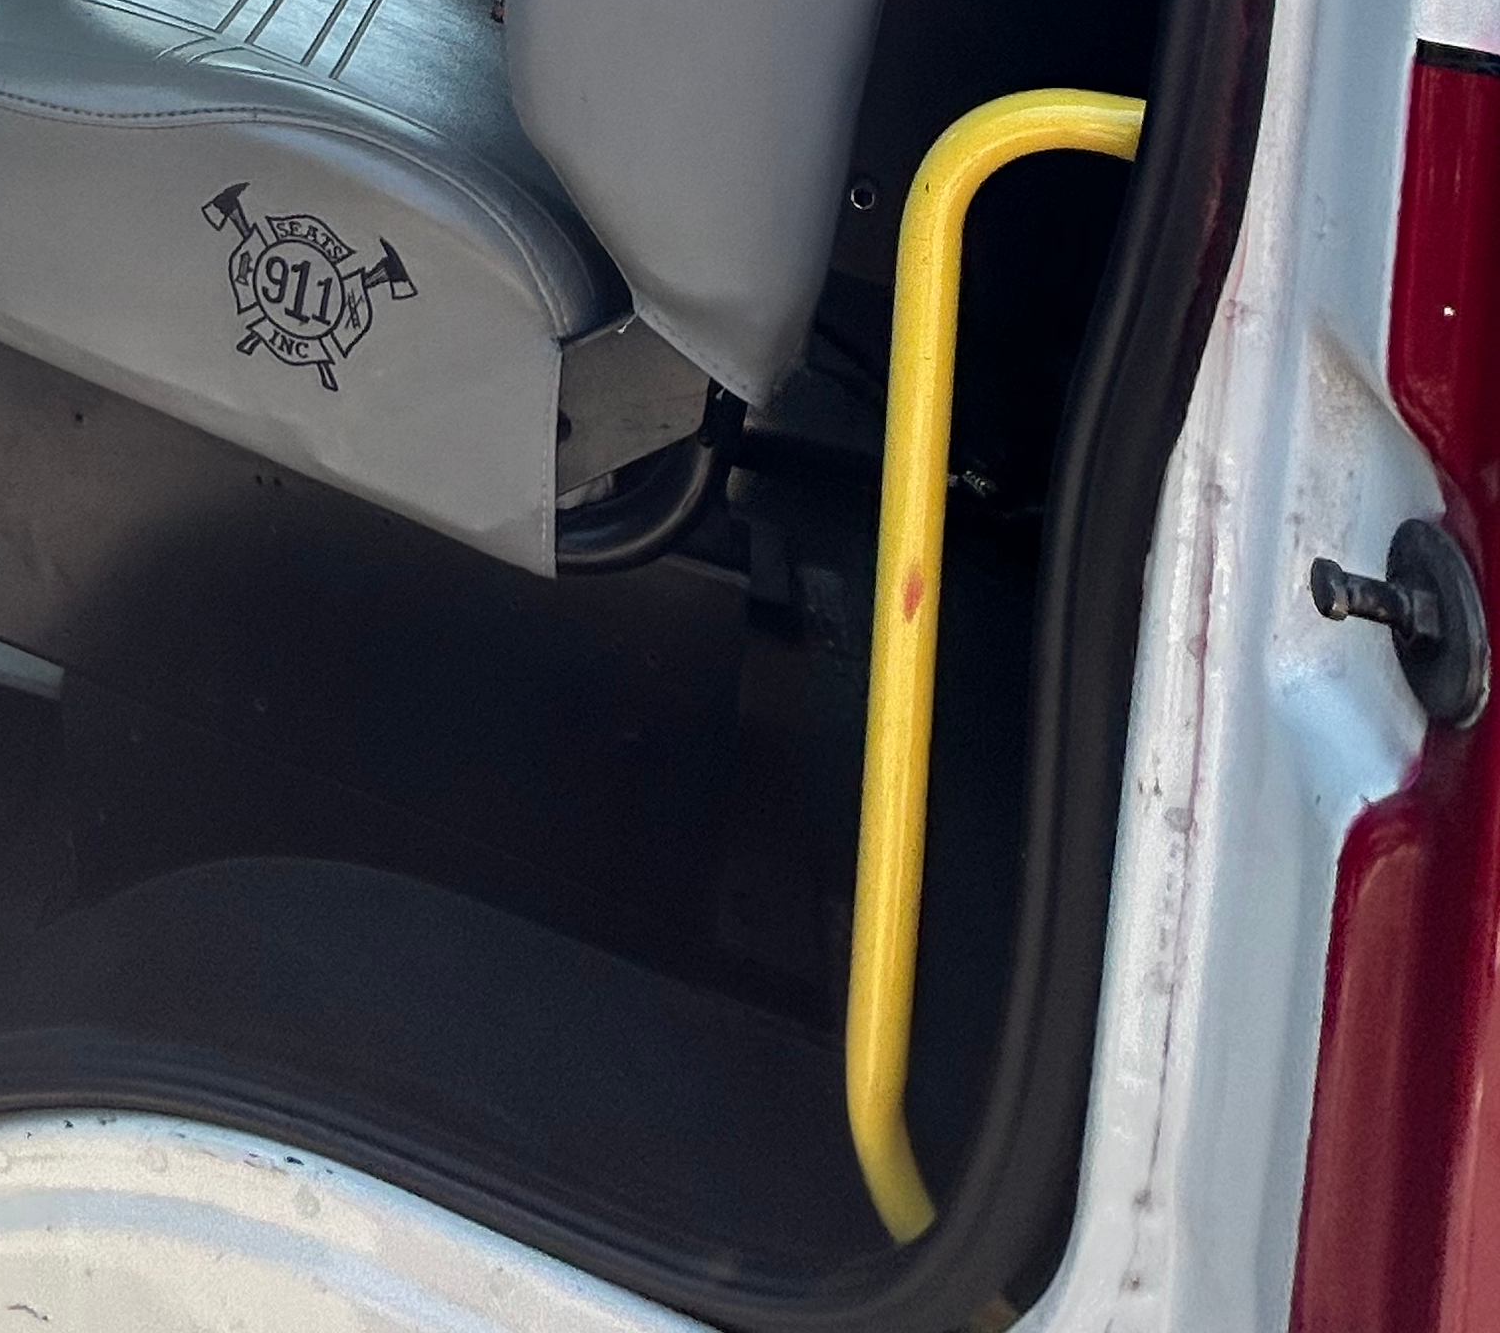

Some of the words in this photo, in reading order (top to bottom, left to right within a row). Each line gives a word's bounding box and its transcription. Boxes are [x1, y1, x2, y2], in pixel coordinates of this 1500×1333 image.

[276, 221, 345, 261] SEATS
[261, 255, 333, 326] 911
[268, 329, 310, 359] INC
